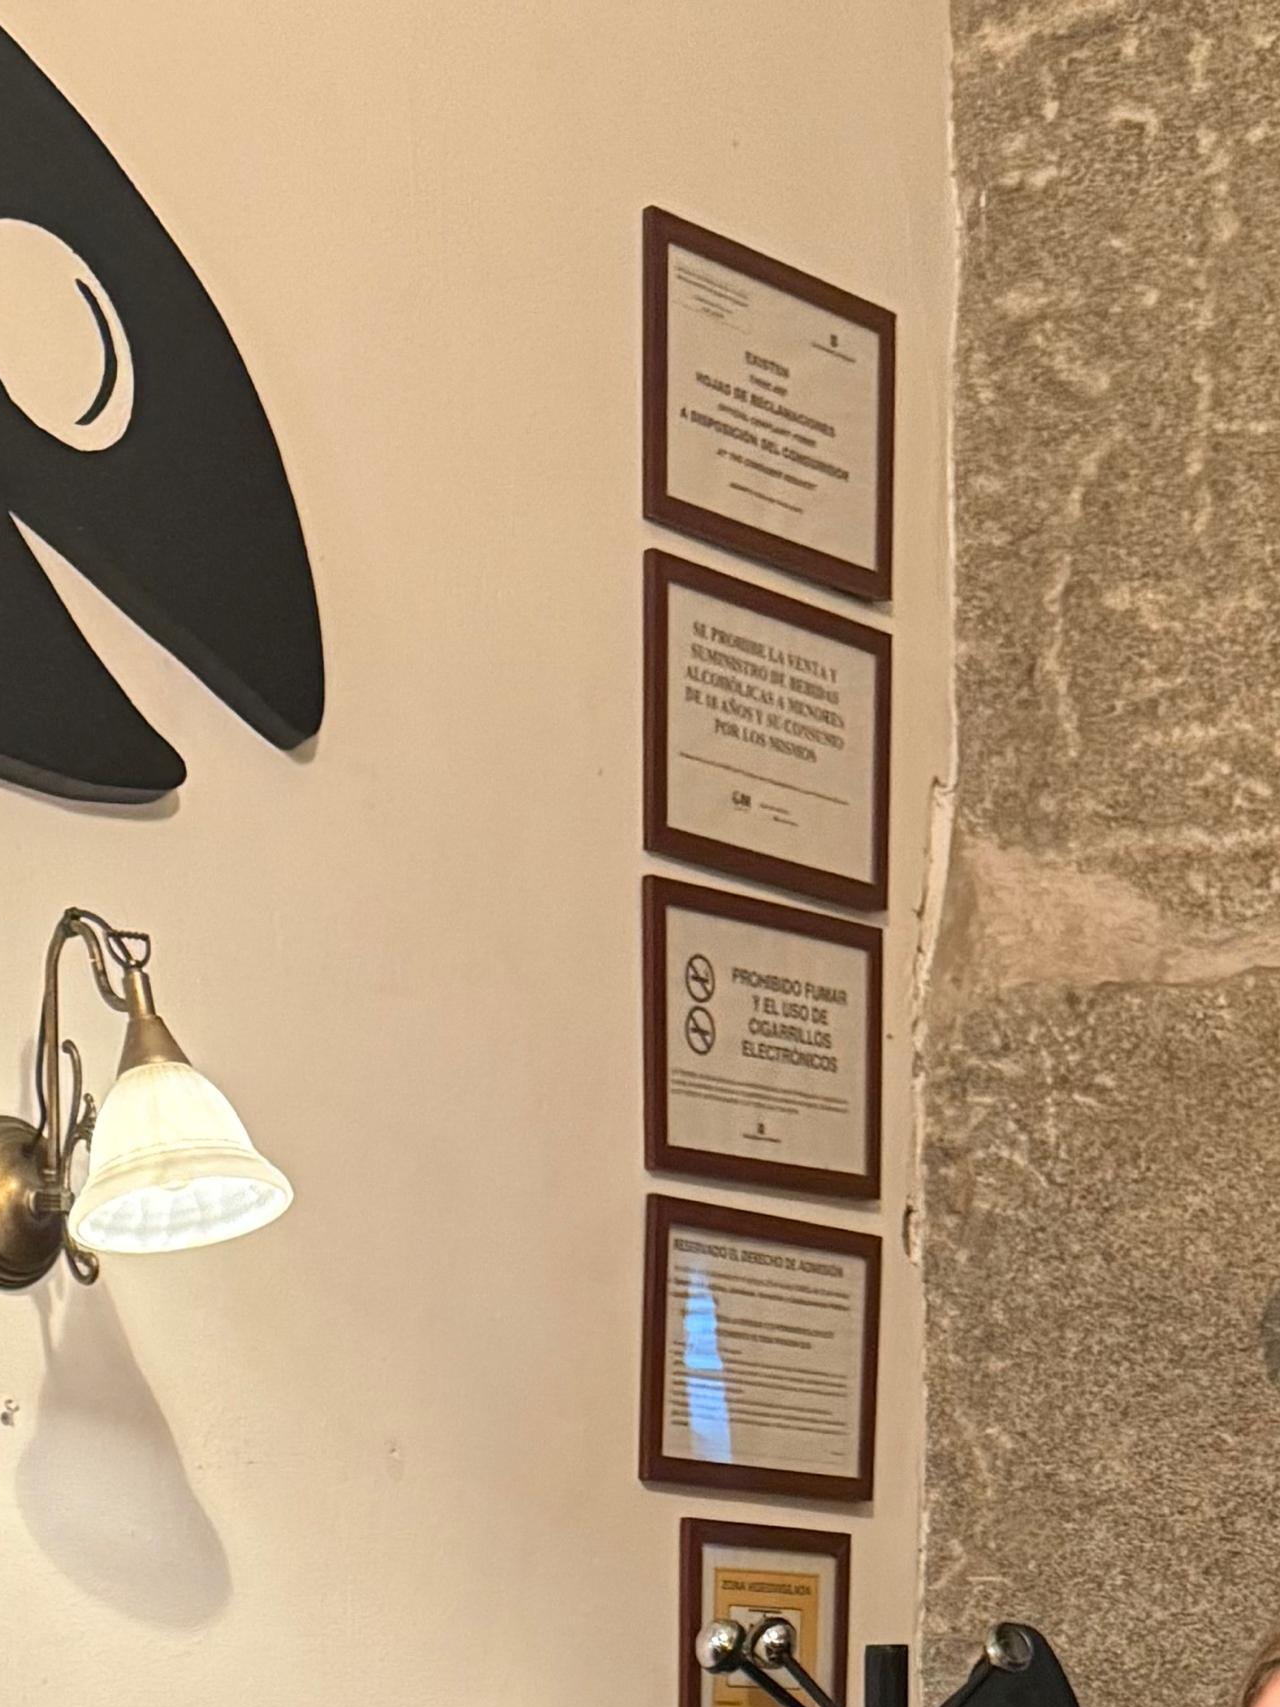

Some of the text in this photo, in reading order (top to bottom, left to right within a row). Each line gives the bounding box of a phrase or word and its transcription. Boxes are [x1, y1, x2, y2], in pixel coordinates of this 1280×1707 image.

[768, 646, 786, 665] LA
[770, 669, 786, 687] DE
[684, 686, 704, 706] DE
[719, 693, 756, 721] AÑOS
[715, 719, 740, 741] POR
[742, 729, 766, 748] LOS
[731, 967, 847, 1006] PROHIBIDO FUMAR
[751, 995, 828, 1025] Y EL USO DE
[748, 1018, 833, 1049] CIGARRILLOS
[741, 1040, 838, 1073] ELECTRÓNICOS
